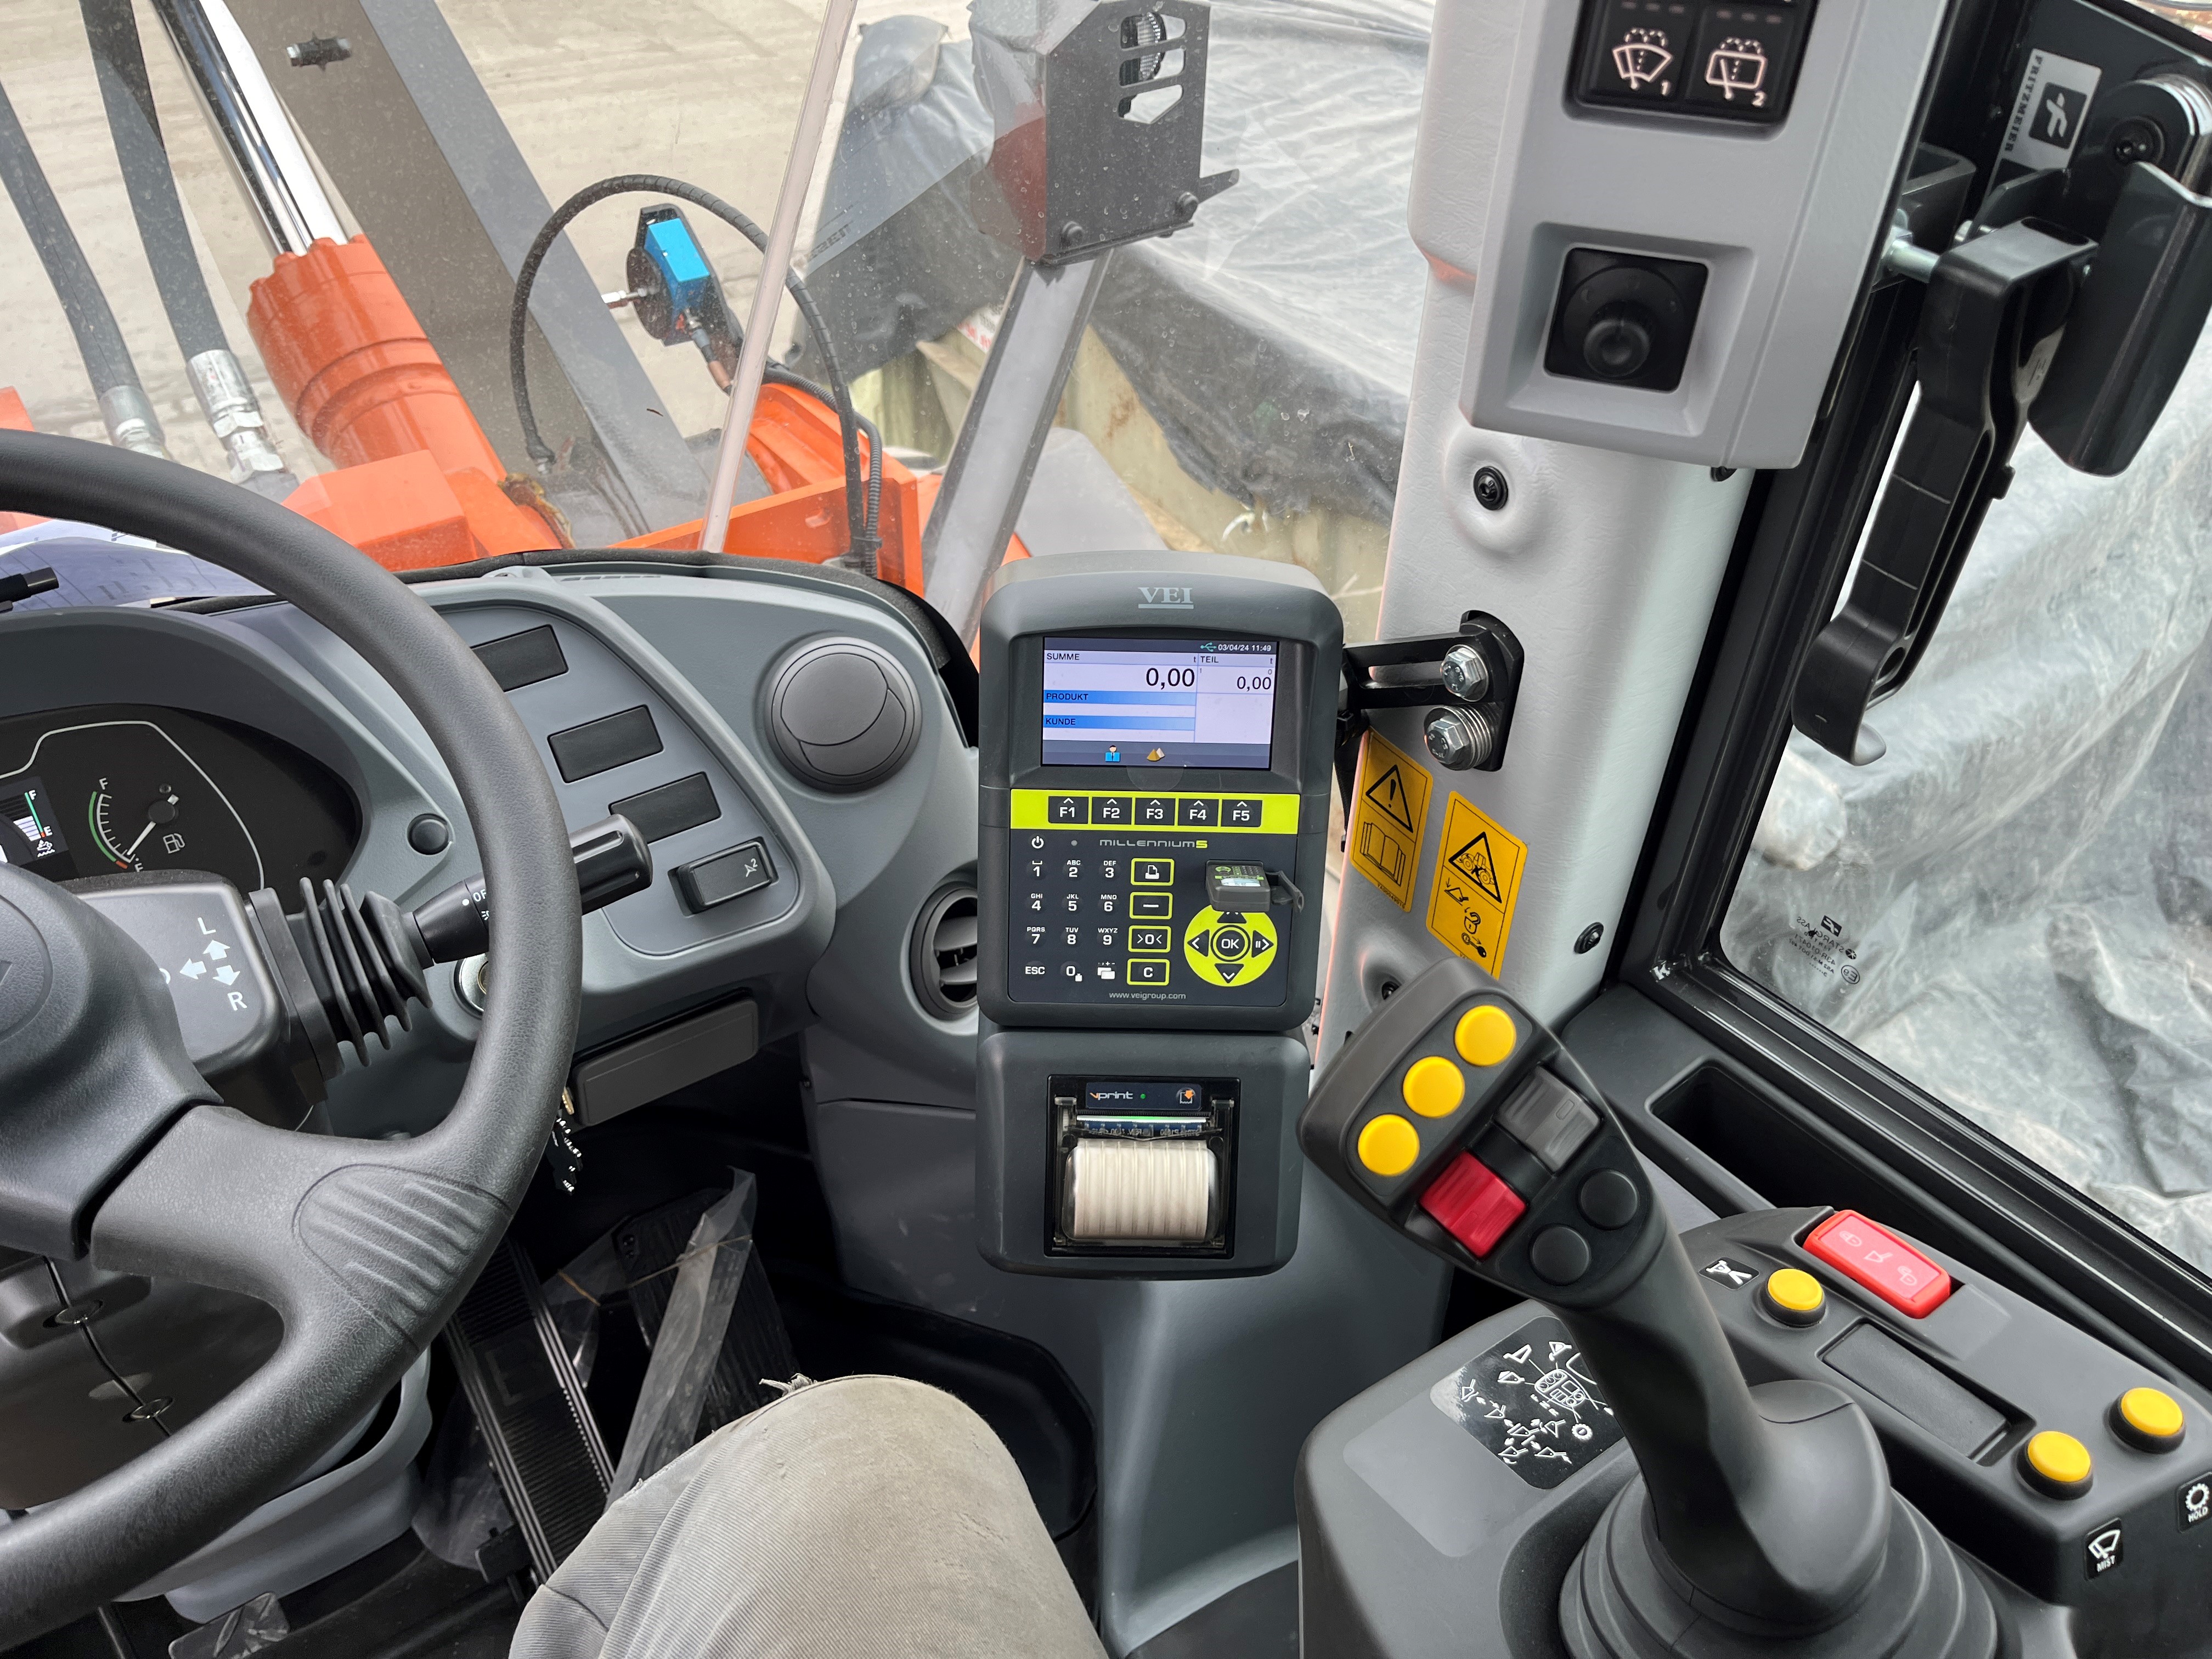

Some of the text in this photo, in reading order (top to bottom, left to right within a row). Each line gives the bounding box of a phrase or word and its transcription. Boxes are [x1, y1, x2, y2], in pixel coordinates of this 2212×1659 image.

[1661, 80, 1669, 96] 1
[1752, 91, 1766, 107] 2
[2005, 54, 2043, 151] FRITZMEIER
[1138, 587, 1194, 603] VEI
[1146, 667, 1195, 690] 0,00
[1237, 676, 1271, 692] 0,00
[1046, 693, 1088, 701] PRODUKT
[1046, 718, 1076, 726] KUNDE
[99, 777, 109, 790] F
[29, 789, 37, 800] F
[1059, 806, 1076, 819] F1
[1103, 808, 1120, 819] F2
[1146, 809, 1164, 820] F3
[1189, 809, 1207, 820] F4
[1233, 810, 1250, 821] F5
[43, 826, 53, 837] E
[1033, 866, 1040, 877] 1
[1069, 867, 1078, 877] 2
[1105, 867, 1114, 878] 3
[1031, 900, 1041, 911] 4
[1068, 901, 1077, 911] 5
[1104, 901, 1113, 912] 6
[198, 917, 216, 935] L
[1031, 934, 1040, 944] 7
[1067, 934, 1076, 945] 8
[1103, 935, 1112, 945] 9
[1221, 938, 1239, 950] OK
[1025, 966, 1045, 975] ESC
[1066, 966, 1075, 976] 0
[1143, 967, 1153, 978] C
[227, 991, 247, 1011] R
[1109, 991, 1186, 1001] www.veigroup.com
[1090, 1091, 1133, 1101] vprint
[2188, 1506, 2209, 1522] HOLD
[2096, 1555, 2115, 1572] MIST
